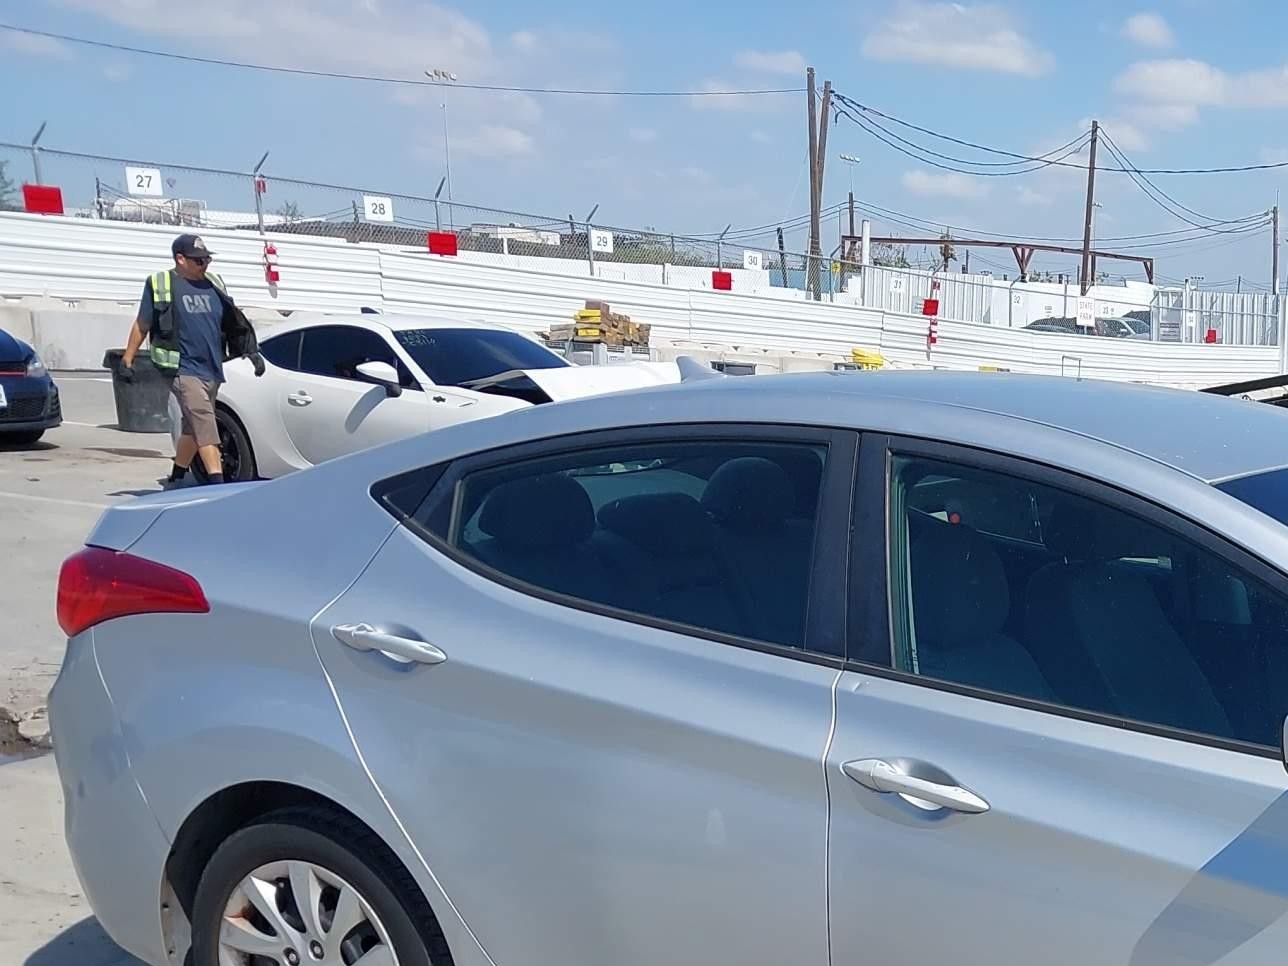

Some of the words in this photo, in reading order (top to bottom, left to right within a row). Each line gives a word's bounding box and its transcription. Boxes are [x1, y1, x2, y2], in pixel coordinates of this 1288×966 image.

[135, 174, 152, 188] 27
[371, 202, 386, 215] 28
[596, 236, 608, 247] 29
[748, 255, 758, 266] 30
[182, 294, 212, 313] CAT
